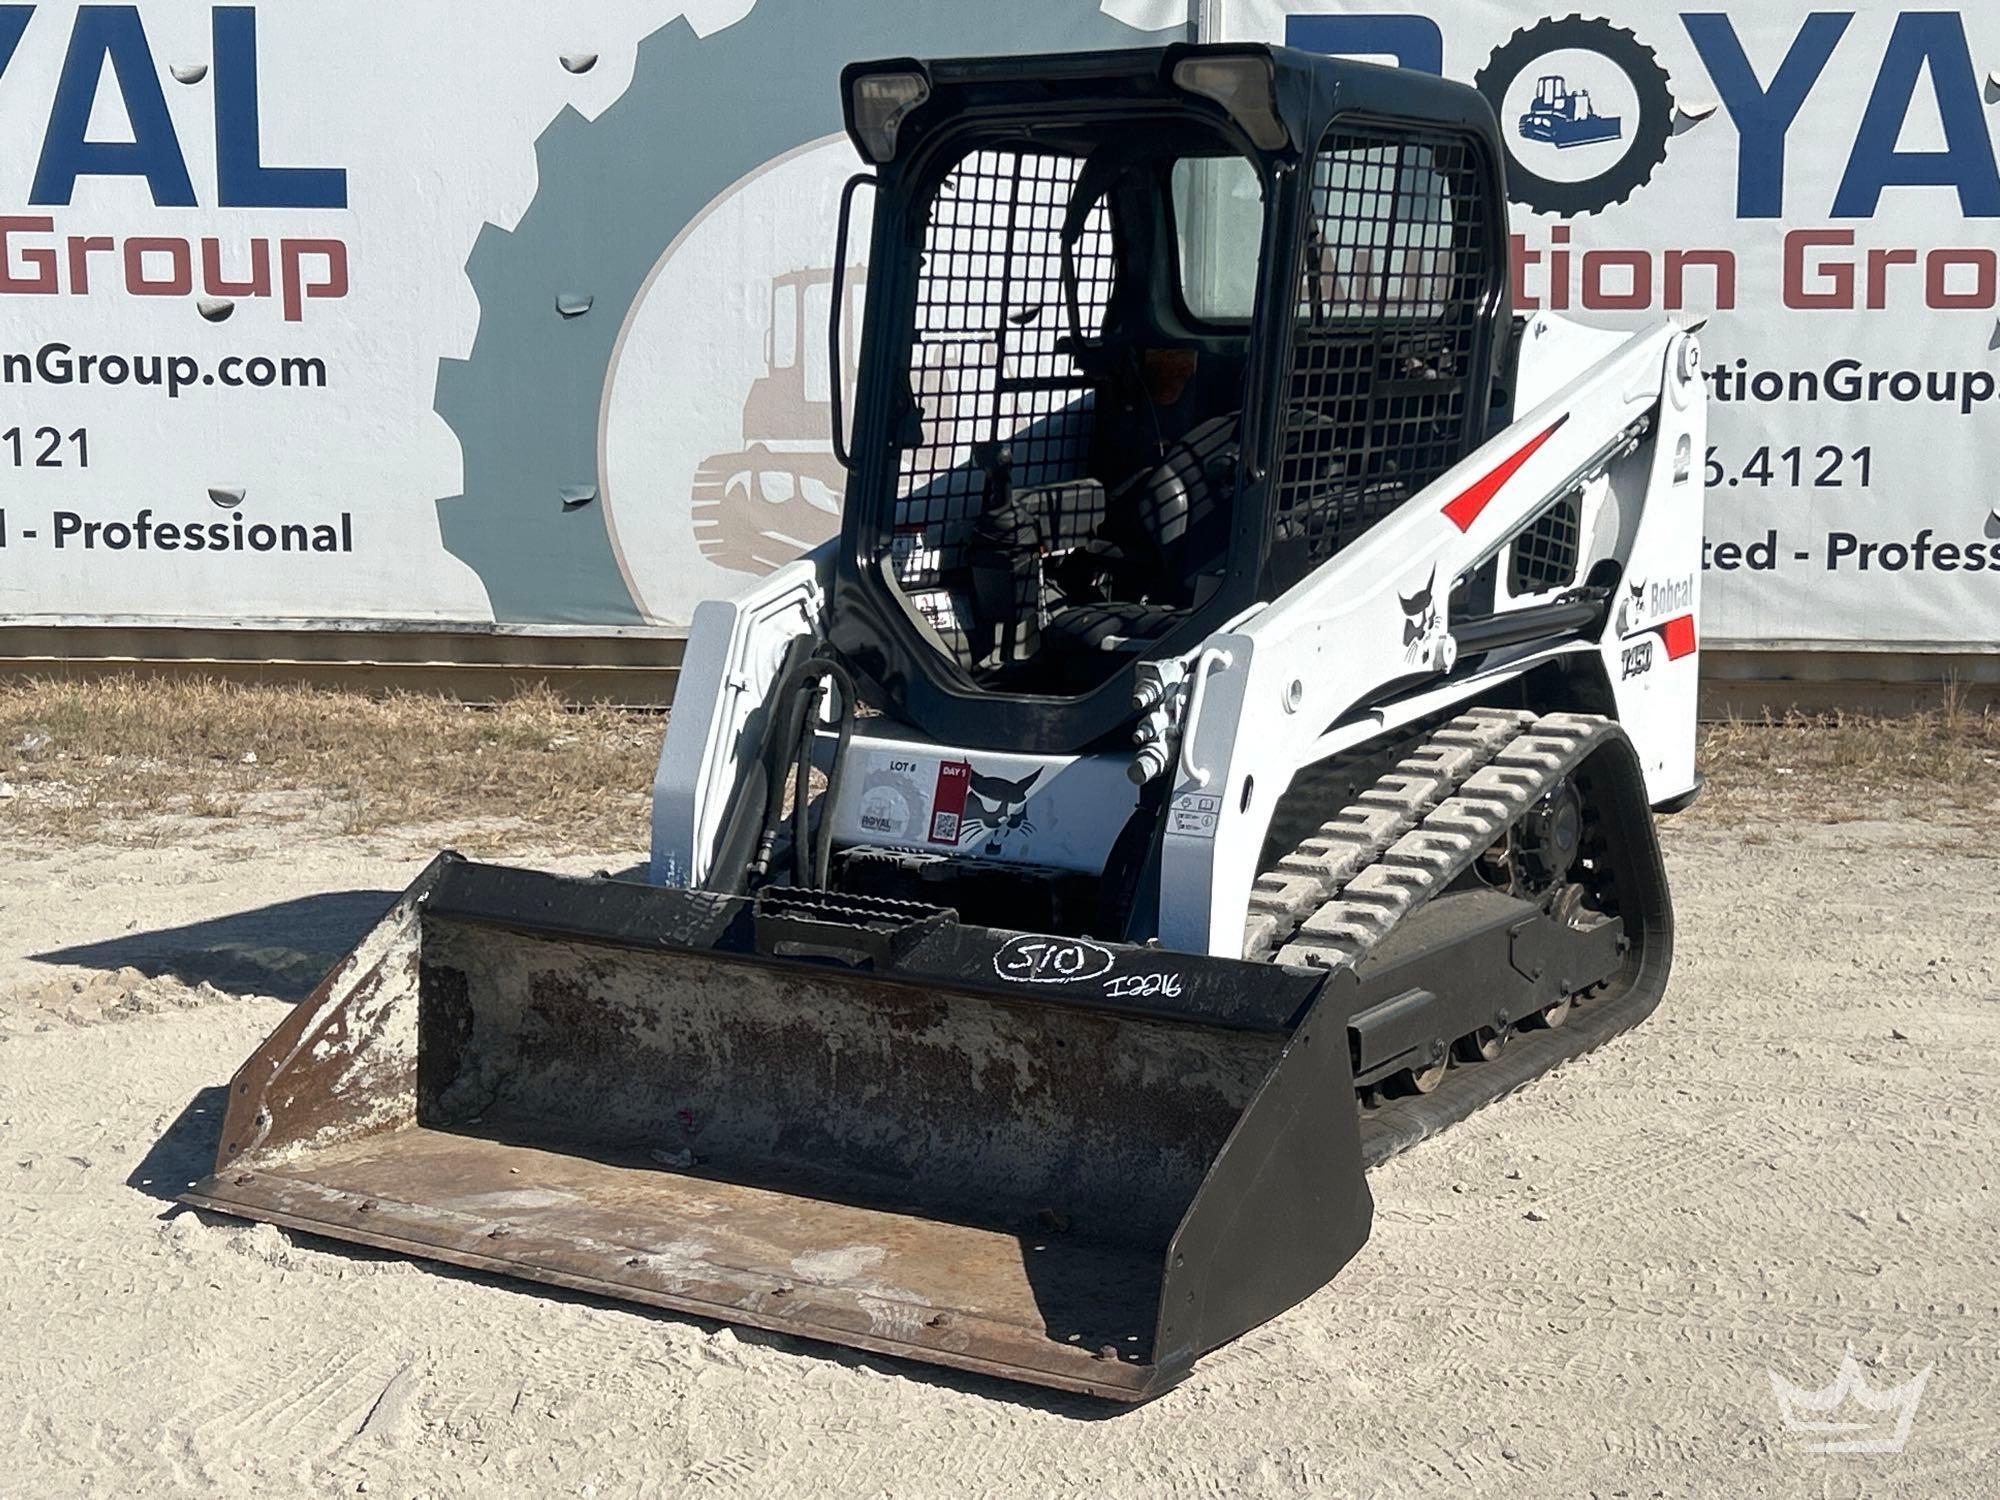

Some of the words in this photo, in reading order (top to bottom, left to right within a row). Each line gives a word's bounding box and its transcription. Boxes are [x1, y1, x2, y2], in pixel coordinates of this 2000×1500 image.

[0, 216, 348, 321] Group
[1783, 229, 1996, 310] Gro
[3, 343, 326, 397] nGroup.com
[2, 426, 88, 468] 121
[53, 509, 352, 552] Professional
[1651, 573, 1693, 618] Bobcat
[890, 761, 908, 772] LOT
[942, 766, 960, 776] DAY
